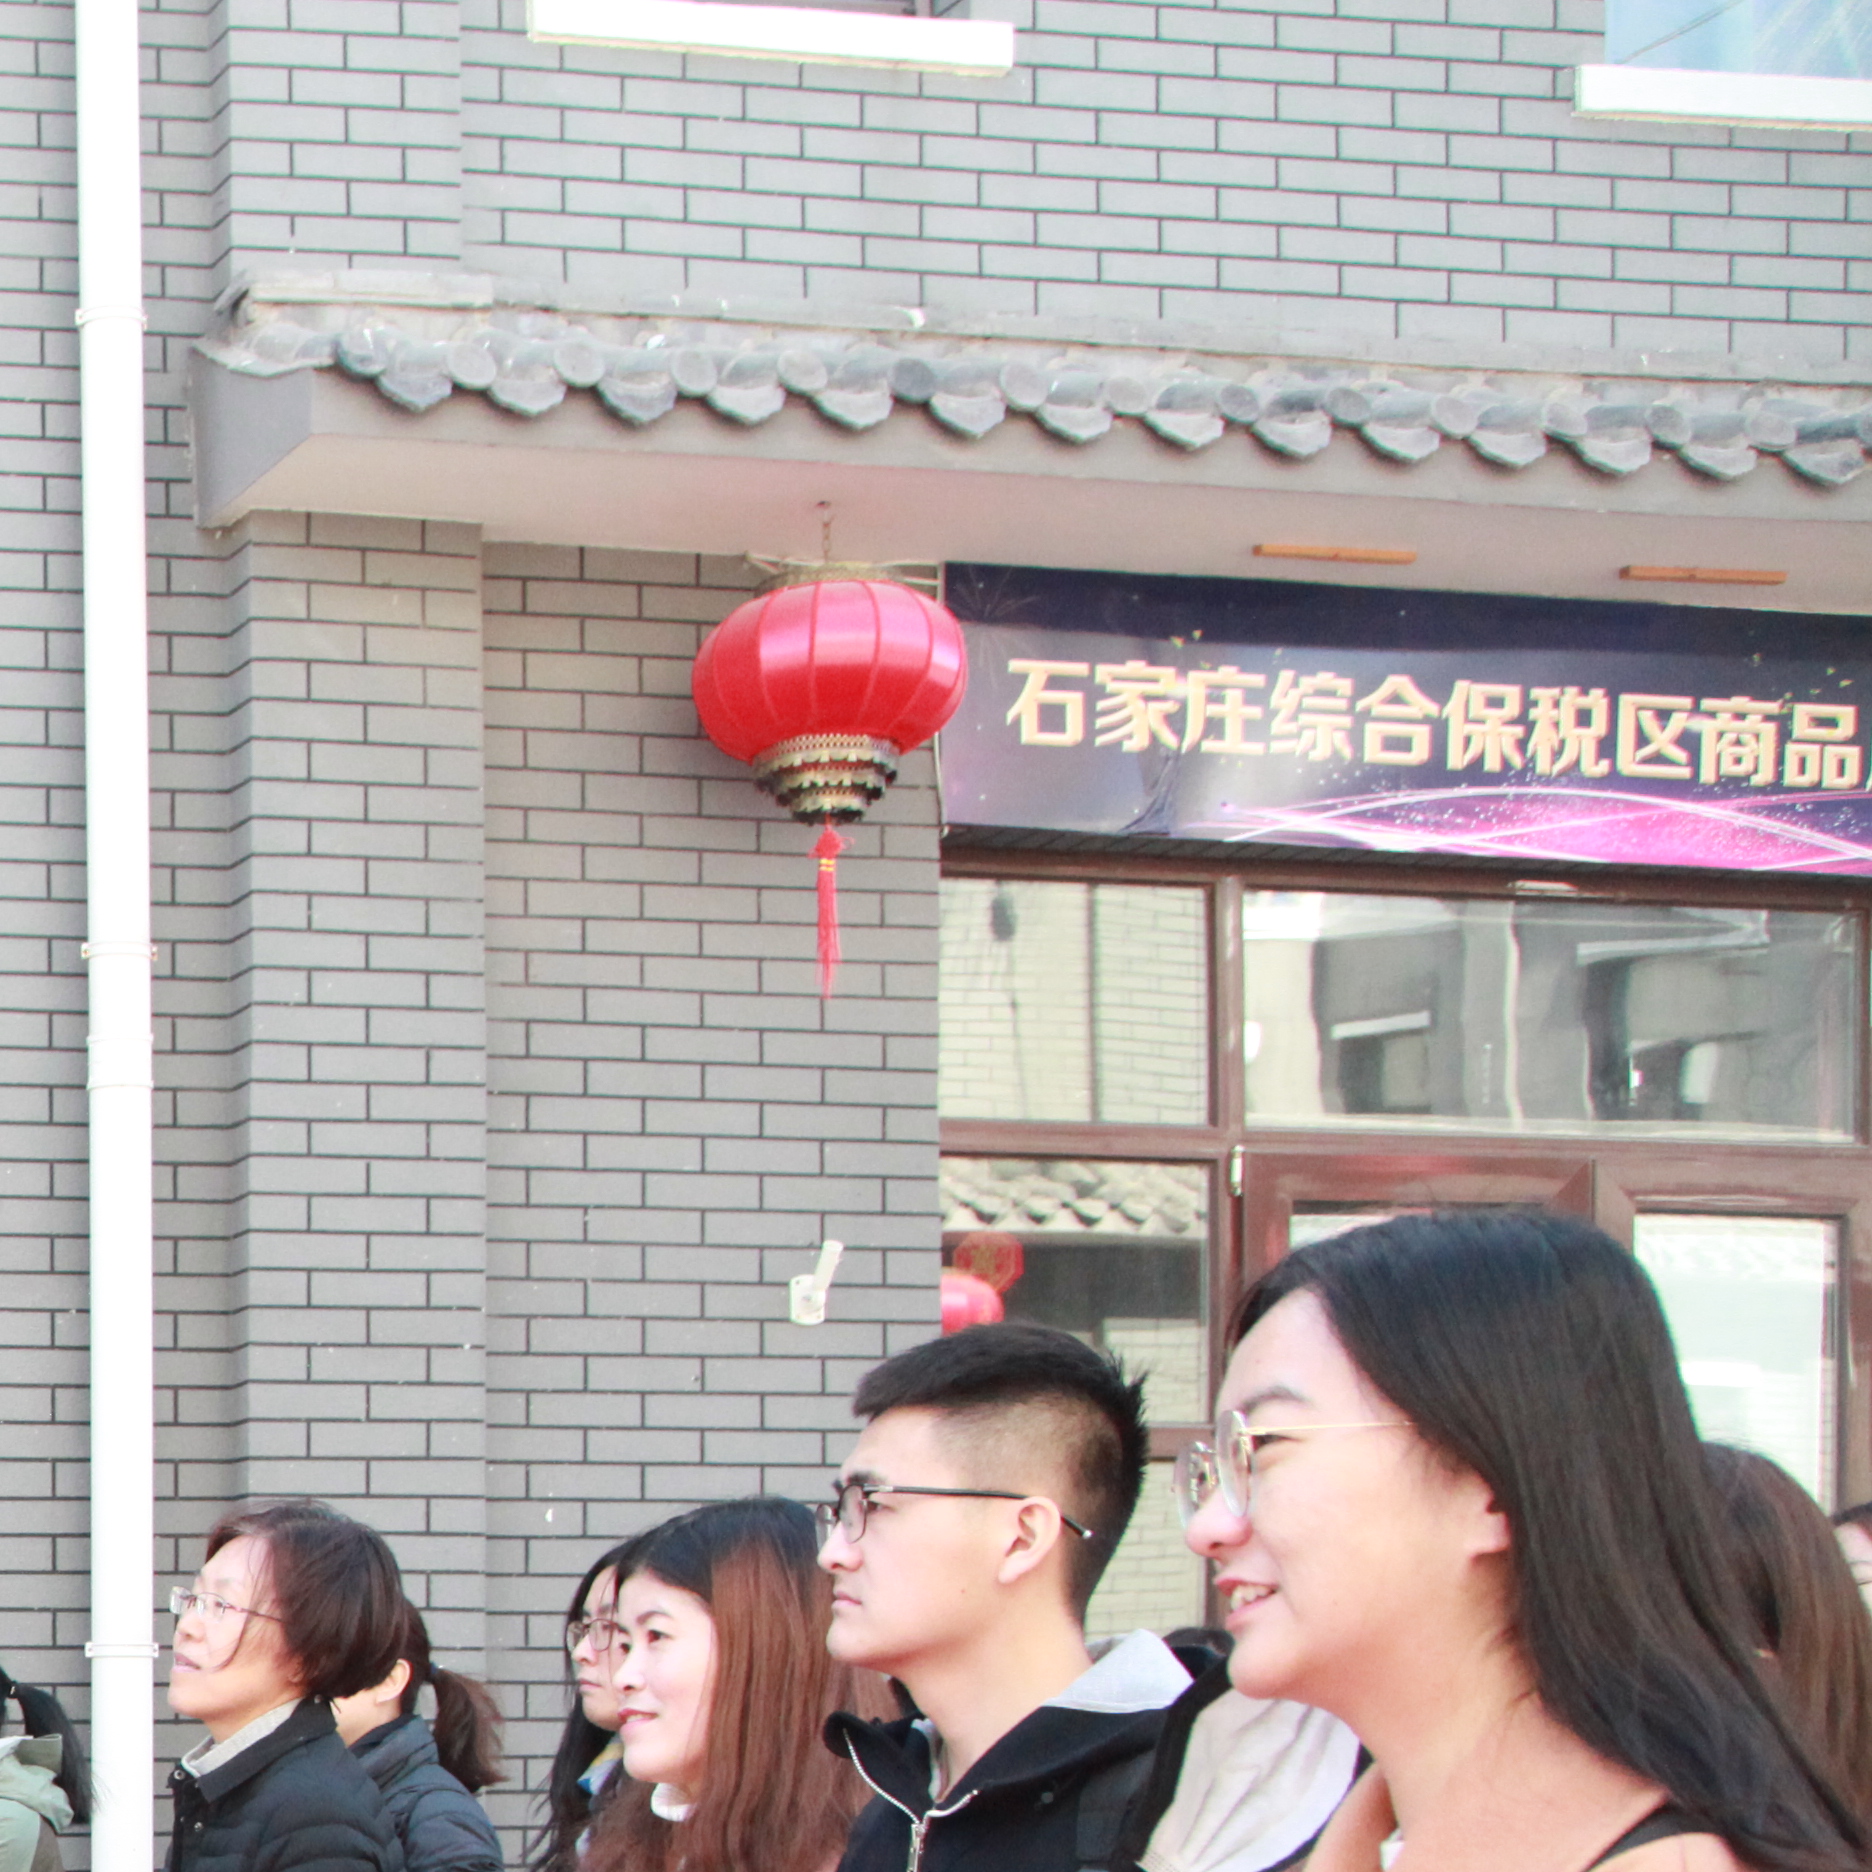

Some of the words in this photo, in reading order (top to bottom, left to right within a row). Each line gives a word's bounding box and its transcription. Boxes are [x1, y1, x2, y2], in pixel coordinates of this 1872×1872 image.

[1006, 658, 1872, 792] 石家庄综合保税区商品
